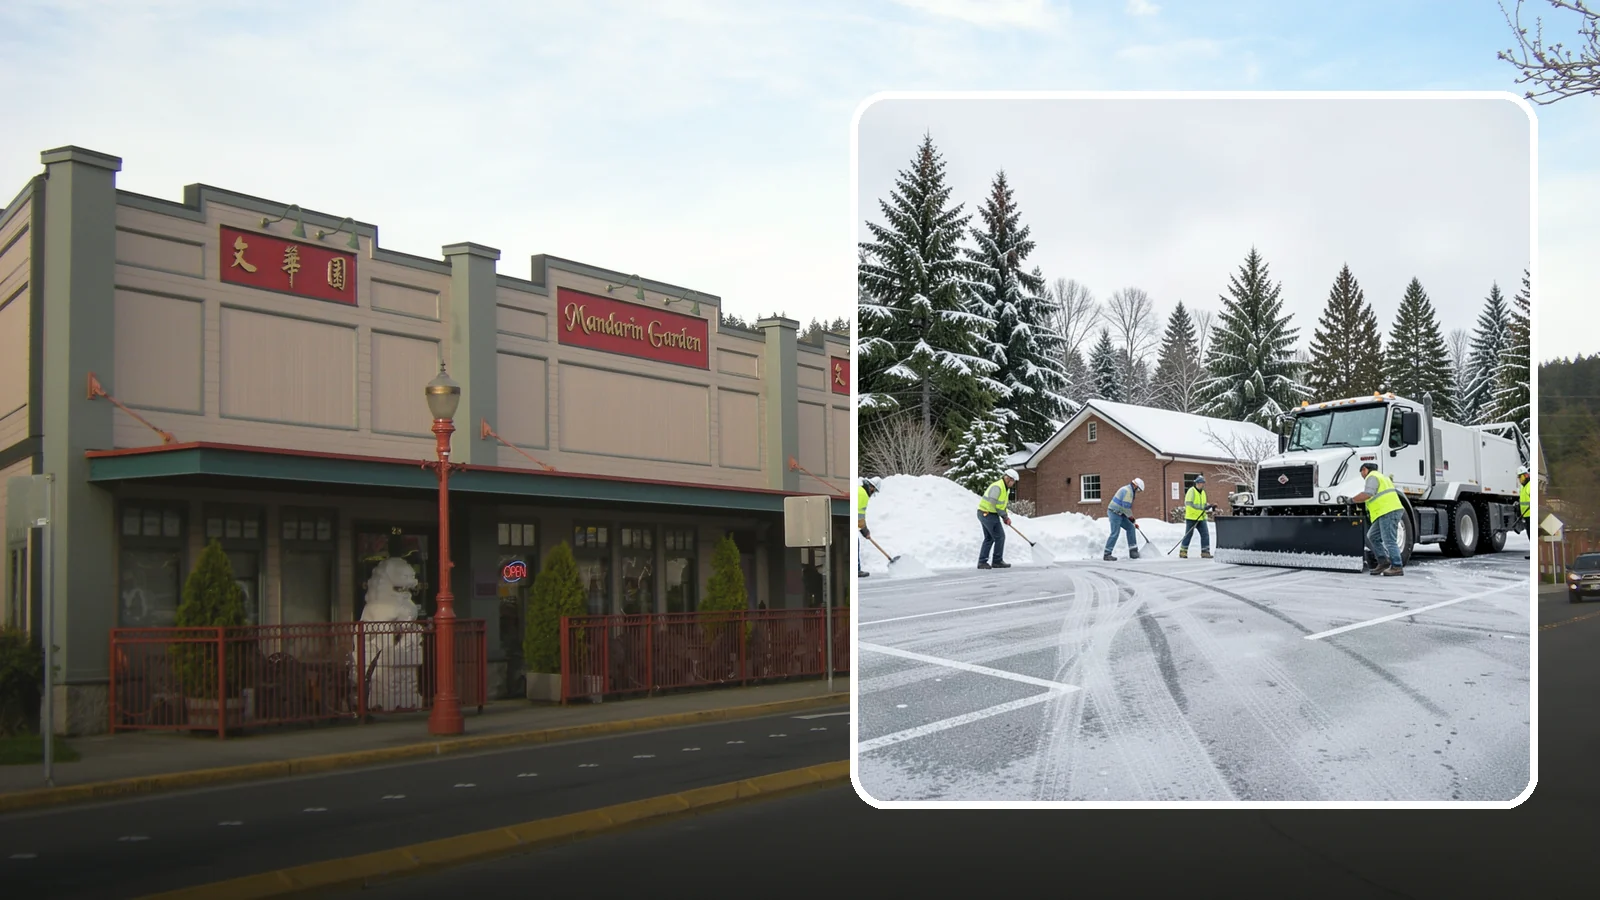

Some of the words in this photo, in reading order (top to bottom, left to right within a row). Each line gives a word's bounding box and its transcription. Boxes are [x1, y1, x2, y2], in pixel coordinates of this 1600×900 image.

[231, 236, 346, 291] 文華園
[564, 302, 644, 341] Mandarin
[648, 320, 702, 352] Garden
[503, 565, 526, 578] OPEN
